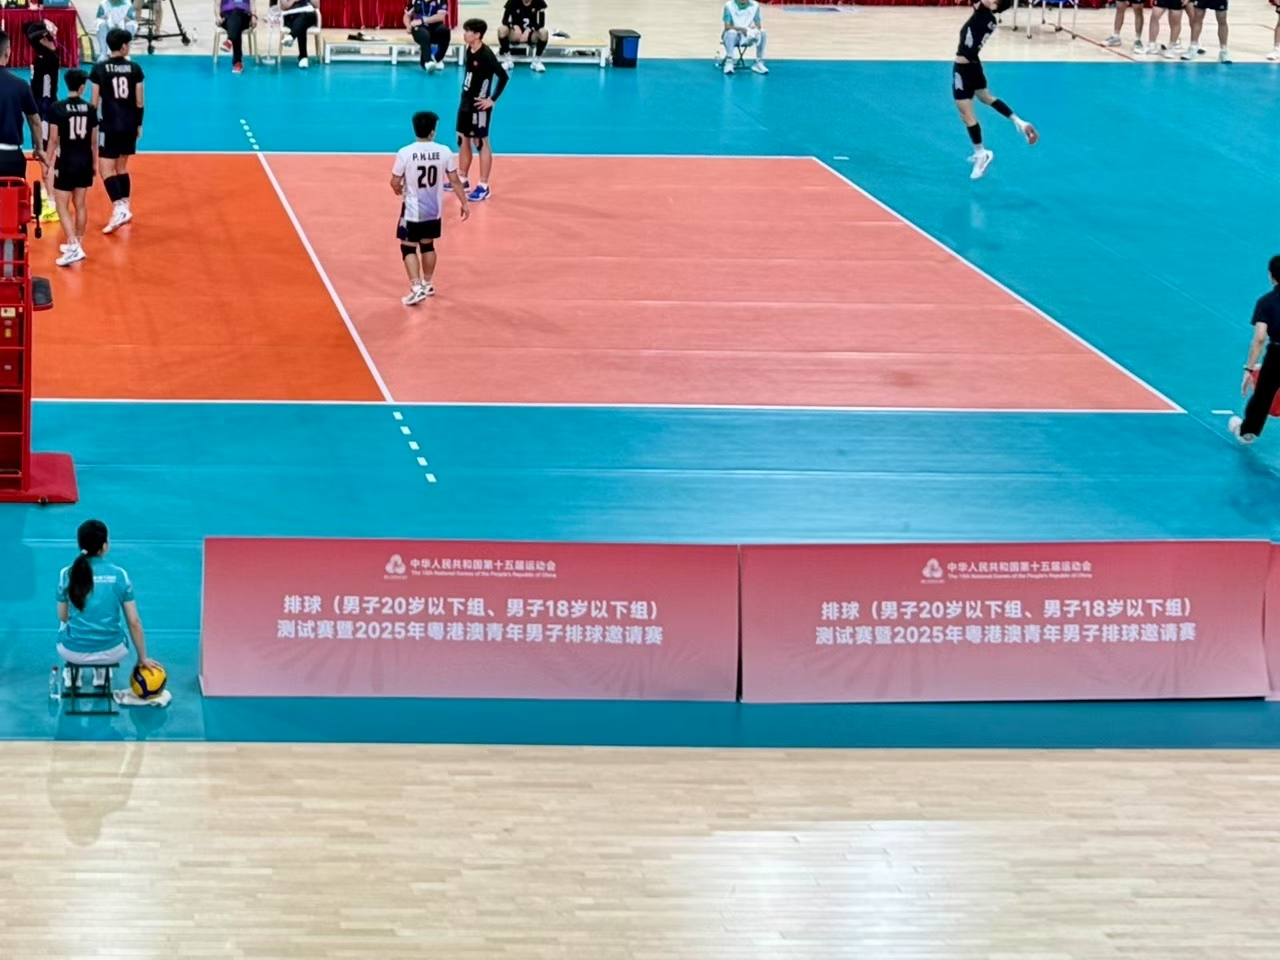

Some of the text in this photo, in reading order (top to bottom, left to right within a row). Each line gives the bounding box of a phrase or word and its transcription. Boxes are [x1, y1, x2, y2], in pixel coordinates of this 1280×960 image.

[111, 76, 129, 99] 18
[68, 115, 88, 140] 14
[417, 164, 438, 189] 20
[410, 558, 557, 571] 中华人民共和国第十五届运动会
[947, 561, 1092, 573] 中华人民共和国第十五届运动会
[283, 594, 659, 622] 排球（男子20岁以下组、男子18岁以下组）
[820, 597, 1193, 621] 排球（男子20岁以下组、男子18岁以下组）
